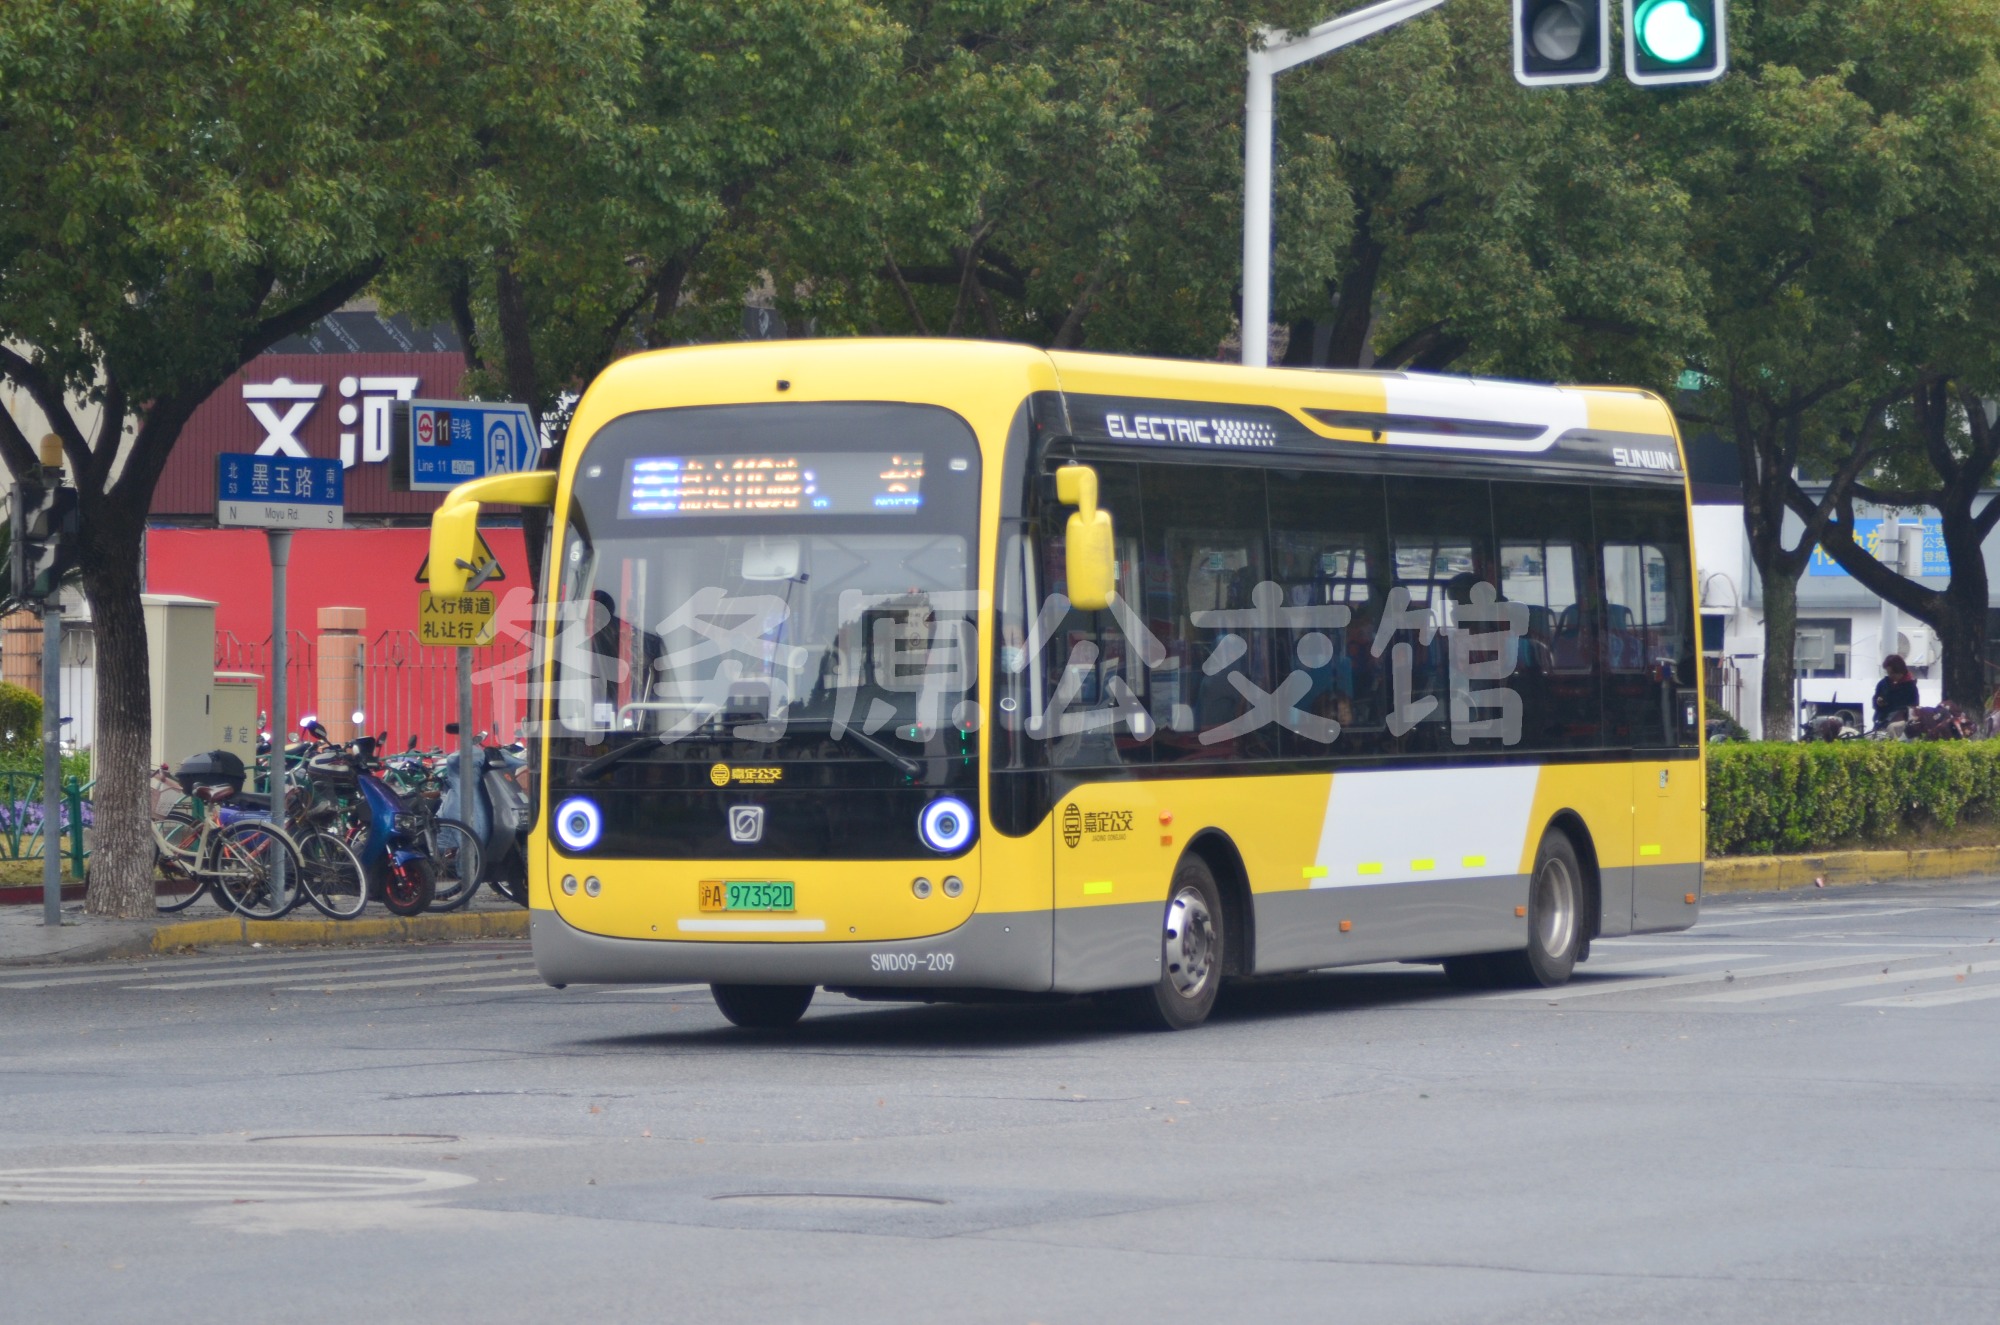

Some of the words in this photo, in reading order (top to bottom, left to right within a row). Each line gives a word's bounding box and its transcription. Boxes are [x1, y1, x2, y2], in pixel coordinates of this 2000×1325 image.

[1106, 414, 1211, 444] ELECTRIC
[418, 459, 433, 472] Line
[438, 461, 446, 473] 11
[453, 461, 474, 473] 400m
[1612, 447, 1675, 470] SUNWIN
[228, 462, 238, 479] 北
[252, 463, 312, 498] 墨玉路
[326, 467, 335, 485] 南
[228, 483, 238, 494] 53
[325, 488, 335, 499] 29
[229, 506, 237, 520] N
[265, 508, 284, 522] Moyu
[327, 511, 334, 524] S
[423, 597, 491, 615] 人行横道
[423, 621, 490, 640] 礼让行人
[1084, 810, 1133, 833] 嘉定公交
[870, 952, 955, 971] SWD09-209
